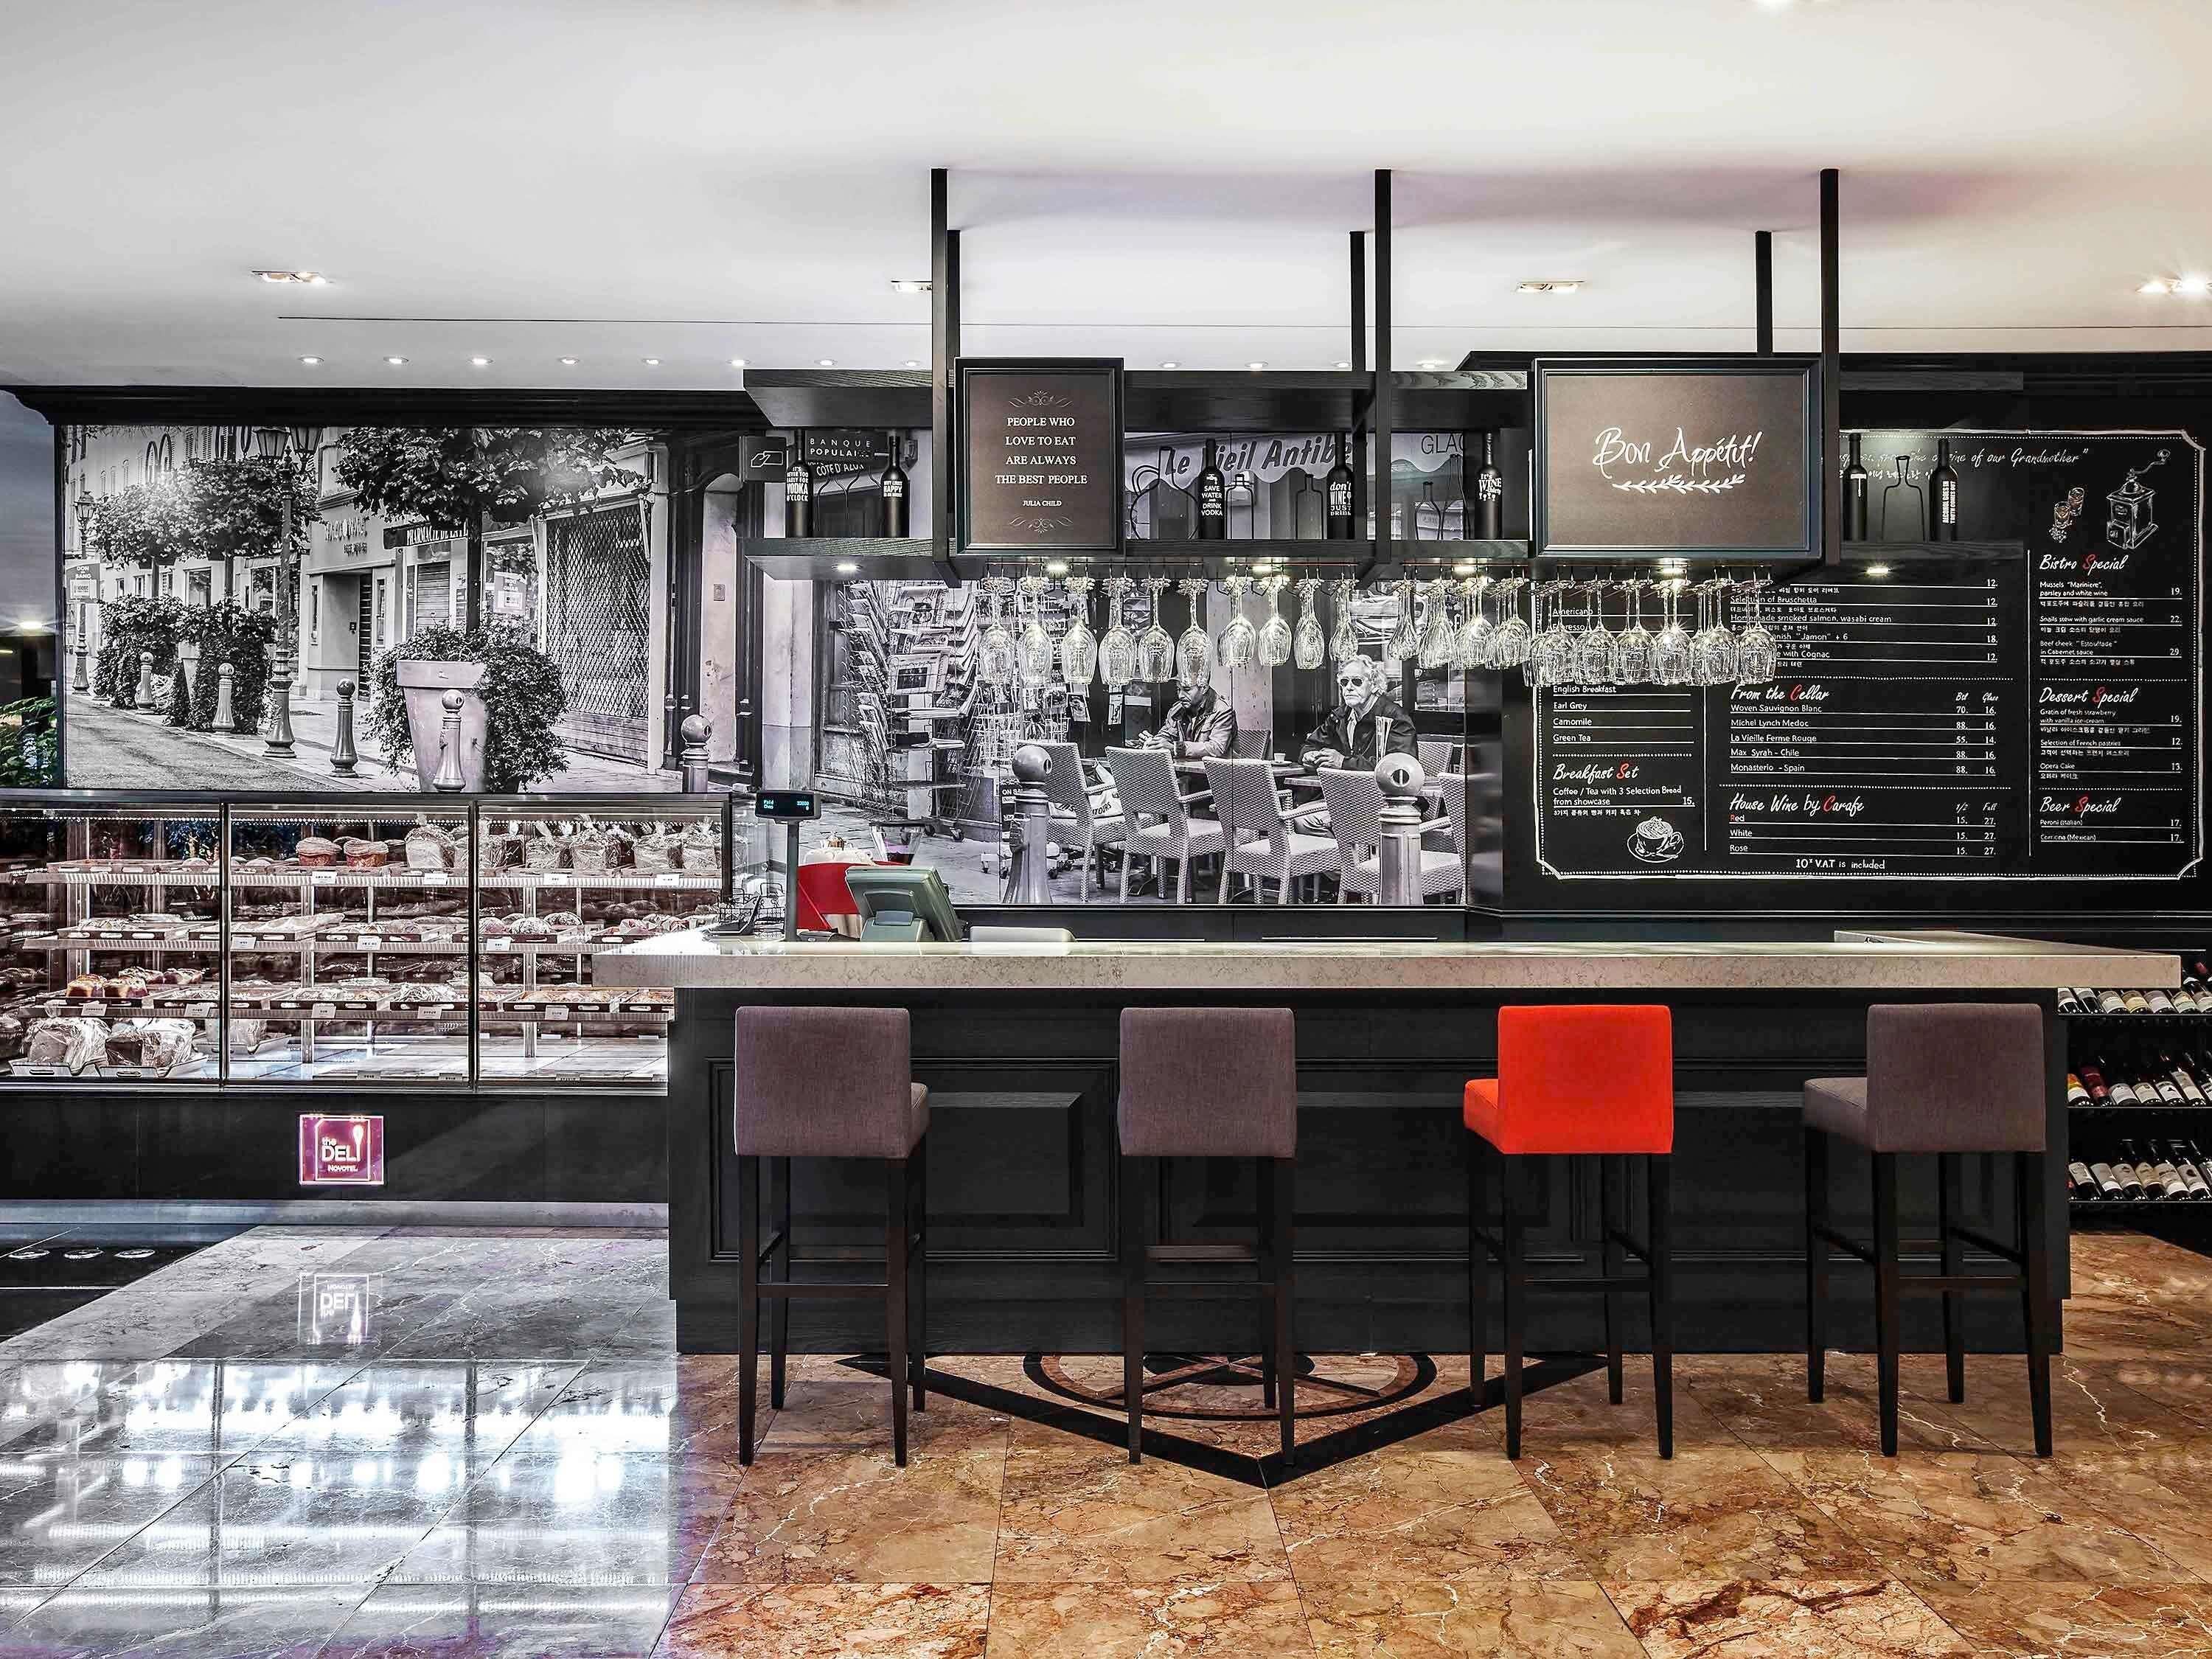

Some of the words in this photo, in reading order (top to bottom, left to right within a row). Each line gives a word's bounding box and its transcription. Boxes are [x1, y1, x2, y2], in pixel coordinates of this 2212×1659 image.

[1006, 417, 1047, 426] PEOPLE
[1049, 417, 1075, 426] WHO
[810, 438, 871, 448] BANQUE
[1005, 437, 1035, 445] LOVE
[1037, 437, 1053, 445] TO
[1054, 437, 1077, 445] EAT
[810, 448, 869, 457] POPULAI
[1593, 427, 1652, 479] Bon
[1654, 426, 1763, 476] Appétit!
[1972, 448, 1982, 467] of
[1987, 454, 2006, 463] our
[1005, 456, 1028, 465] ARE
[1029, 456, 1077, 465] ALWAYS
[995, 475, 1016, 484] THE
[1018, 475, 1044, 484] BEST
[1048, 475, 1088, 484] PEOPLE
[787, 483, 808, 494] VODKA
[1478, 478, 1501, 493] WINE
[1330, 491, 1346, 505] WINE
[2039, 554, 2077, 570] Bistro
[2082, 554, 2129, 576] Special
[1553, 686, 1579, 694] English
[1731, 684, 1761, 700] From
[1765, 685, 1785, 700] the
[1790, 684, 1829, 700] Cellar
[2039, 687, 2088, 703] Dessert
[2092, 686, 2138, 709] Special
[1570, 702, 1587, 711] Grey
[1759, 720, 1780, 728] Lynch
[1792, 734, 1817, 743] Rouge
[1751, 749, 1773, 757] Syrah
[1553, 763, 1615, 784] Breakfast
[1616, 763, 1639, 779] Set
[1626, 787, 1660, 795] Selection
[1661, 785, 1681, 794] Bread
[1729, 792, 1764, 811] House
[1770, 793, 1798, 812] Wine
[1804, 793, 1820, 816] by
[1823, 795, 1864, 817] Carafe
[2039, 796, 2070, 813] Beer
[2075, 796, 2122, 818] Special
[1730, 814, 1745, 822] Red
[1730, 829, 1753, 837] White
[1851, 859, 1885, 869] included
[321, 1136, 336, 1146] the
[321, 1140, 361, 1162] DELI
